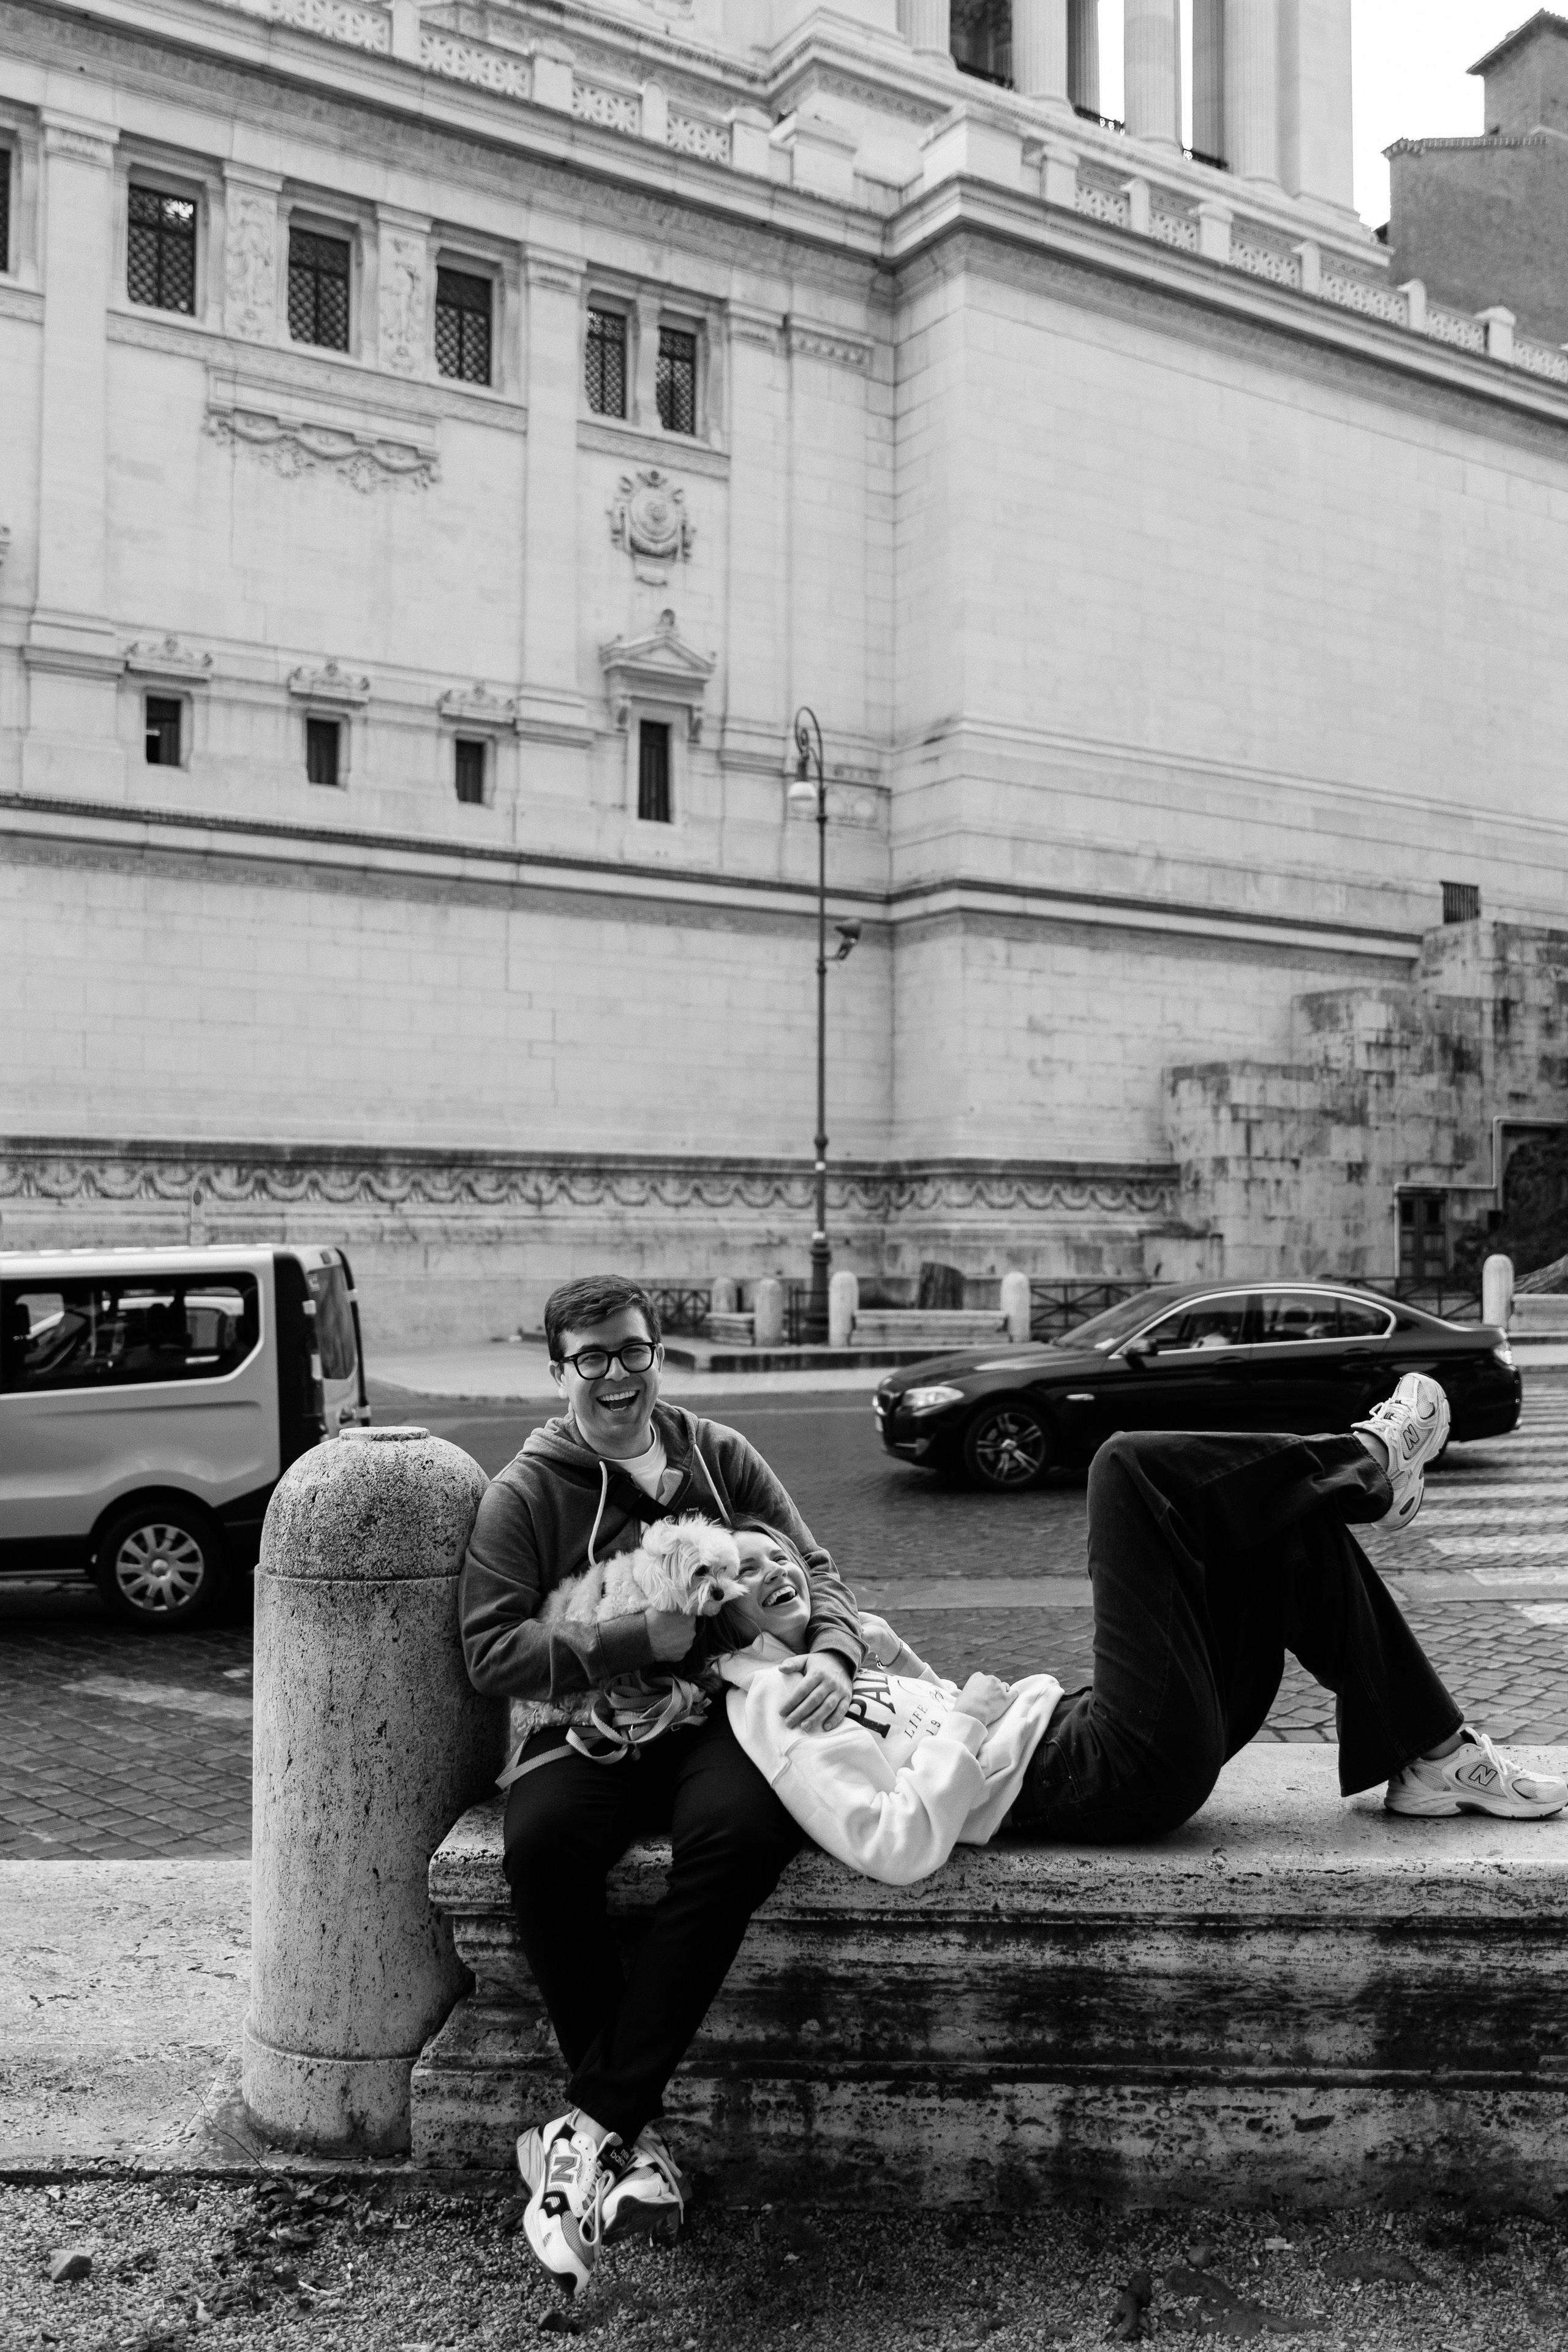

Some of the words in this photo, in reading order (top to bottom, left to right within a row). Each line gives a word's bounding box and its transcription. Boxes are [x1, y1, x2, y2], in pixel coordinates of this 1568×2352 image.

[1403, 1423, 1419, 1450] N
[904, 1705, 928, 1738] LIFE
[1468, 1764, 1498, 1786] N
[550, 2156, 578, 2184] N
